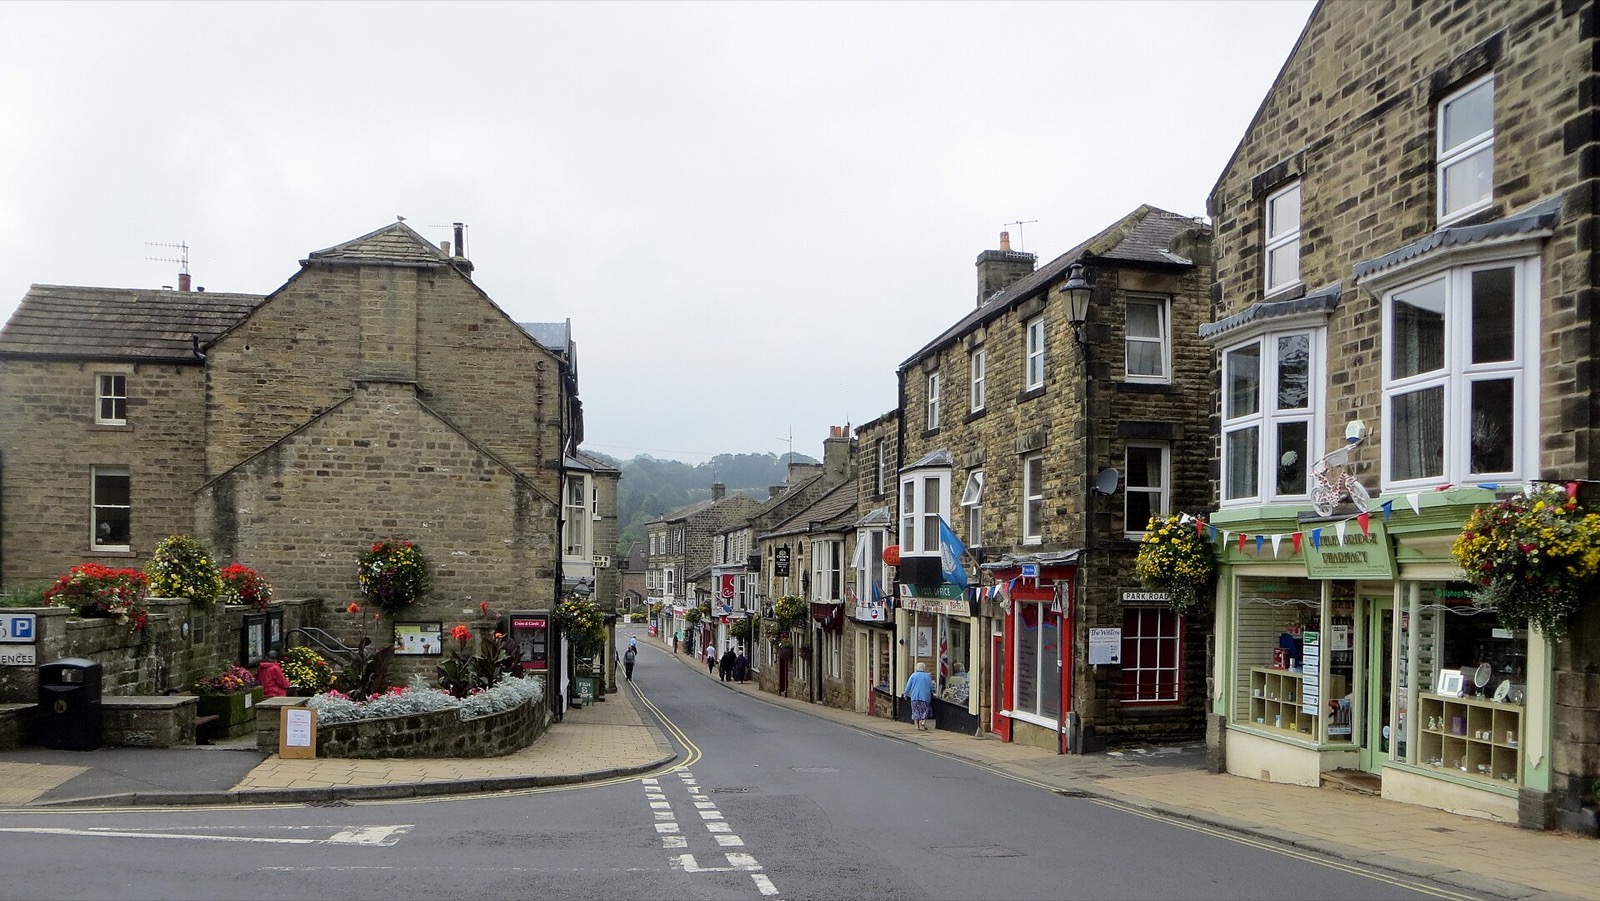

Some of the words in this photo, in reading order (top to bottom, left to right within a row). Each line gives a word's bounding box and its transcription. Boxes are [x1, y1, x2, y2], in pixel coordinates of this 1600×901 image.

[1322, 551, 1368, 564] PHARMACY
[934, 588, 950, 596] OFFICE
[16, 620, 29, 636] P
